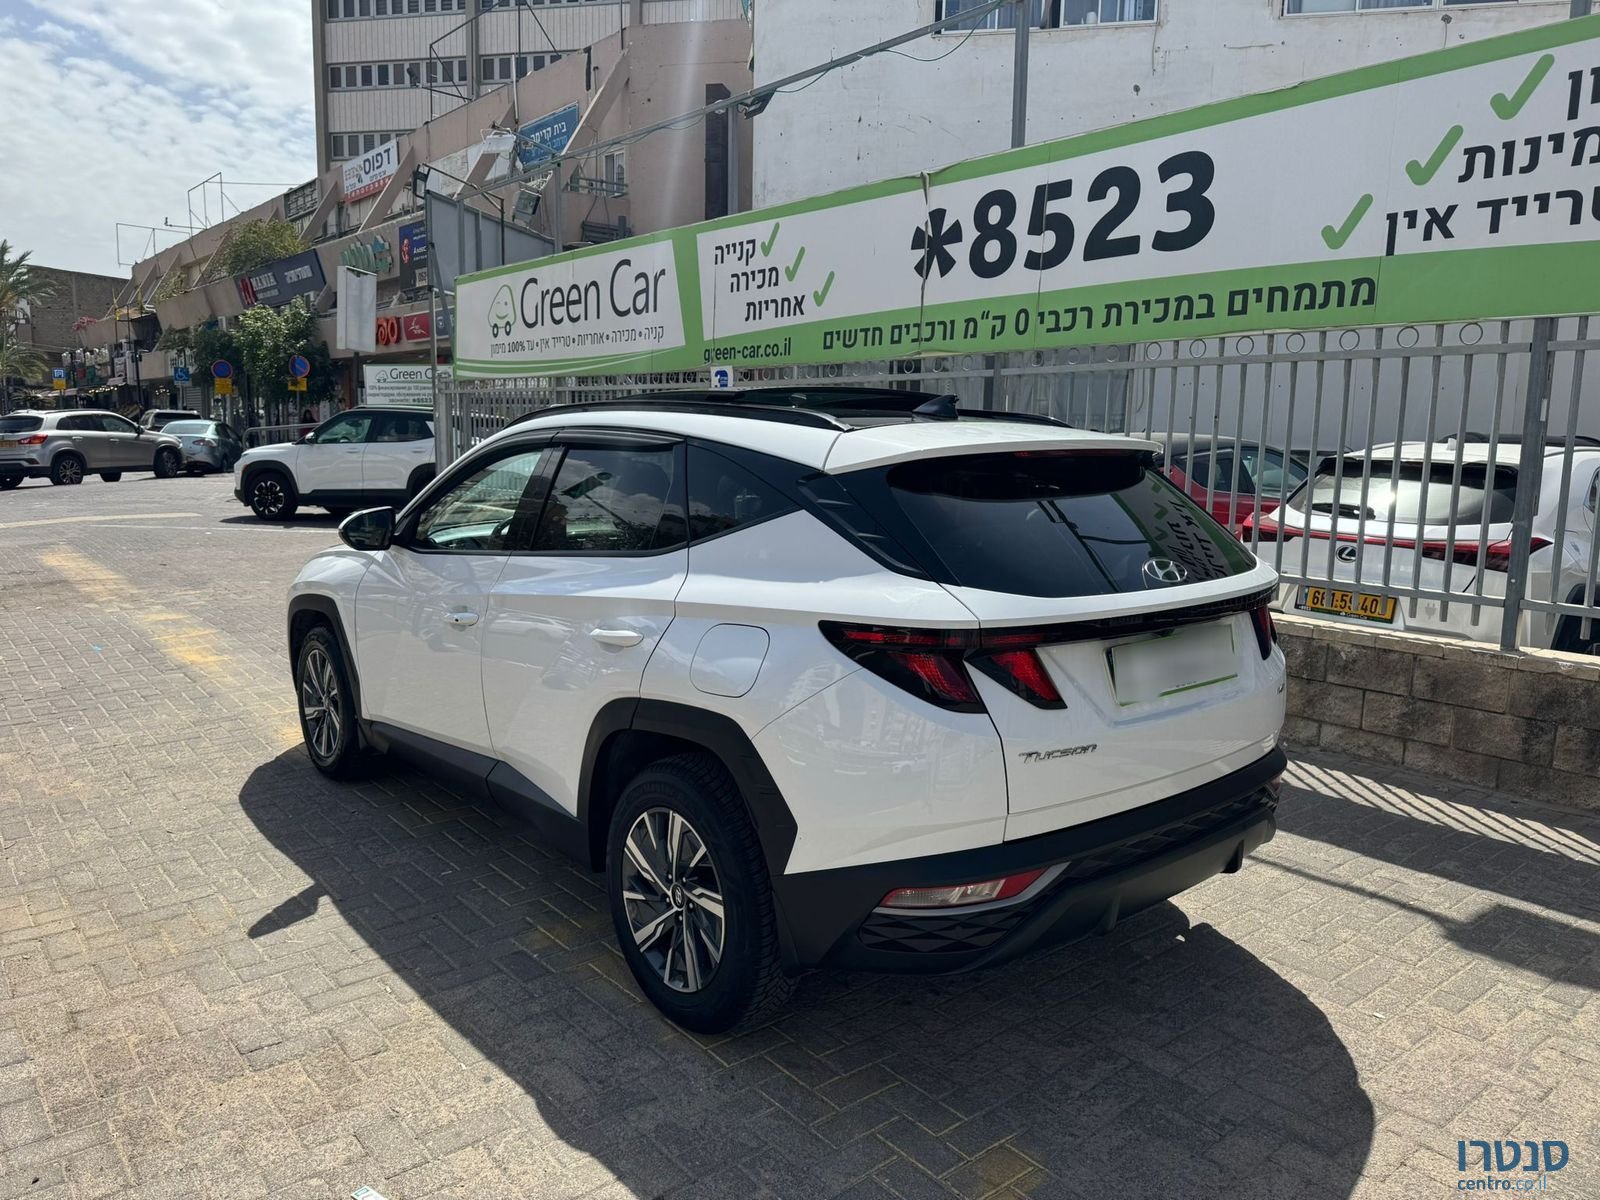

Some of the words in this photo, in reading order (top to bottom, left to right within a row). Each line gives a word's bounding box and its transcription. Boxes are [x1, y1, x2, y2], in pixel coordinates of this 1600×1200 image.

[363, 148, 391, 175] דפוס
[1386, 205, 1459, 257] אין
[714, 239, 756, 267] קנייה
[730, 267, 779, 293] מכירה
[520, 277, 601, 329] Green
[610, 258, 666, 317] Car
[1228, 278, 1376, 316] מתמחים
[745, 295, 806, 322] אחריות
[1038, 307, 1093, 334] רכבי
[1102, 294, 1215, 327] במכירת
[643, 326, 664, 343] קניה
[890, 320, 956, 345] ורכבים
[1015, 308, 1030, 336] 0
[507, 339, 526, 353] 100%
[526, 339, 535, 351] עד
[540, 338, 550, 353] אין
[551, 336, 571, 349] טרייד
[577, 332, 605, 346] אחריות
[611, 329, 637, 343] מכירה
[823, 327, 883, 351] חדשים
[490, 342, 506, 358] מימון
[704, 337, 792, 363] green-car.co.il
[389, 368, 422, 380] Green
